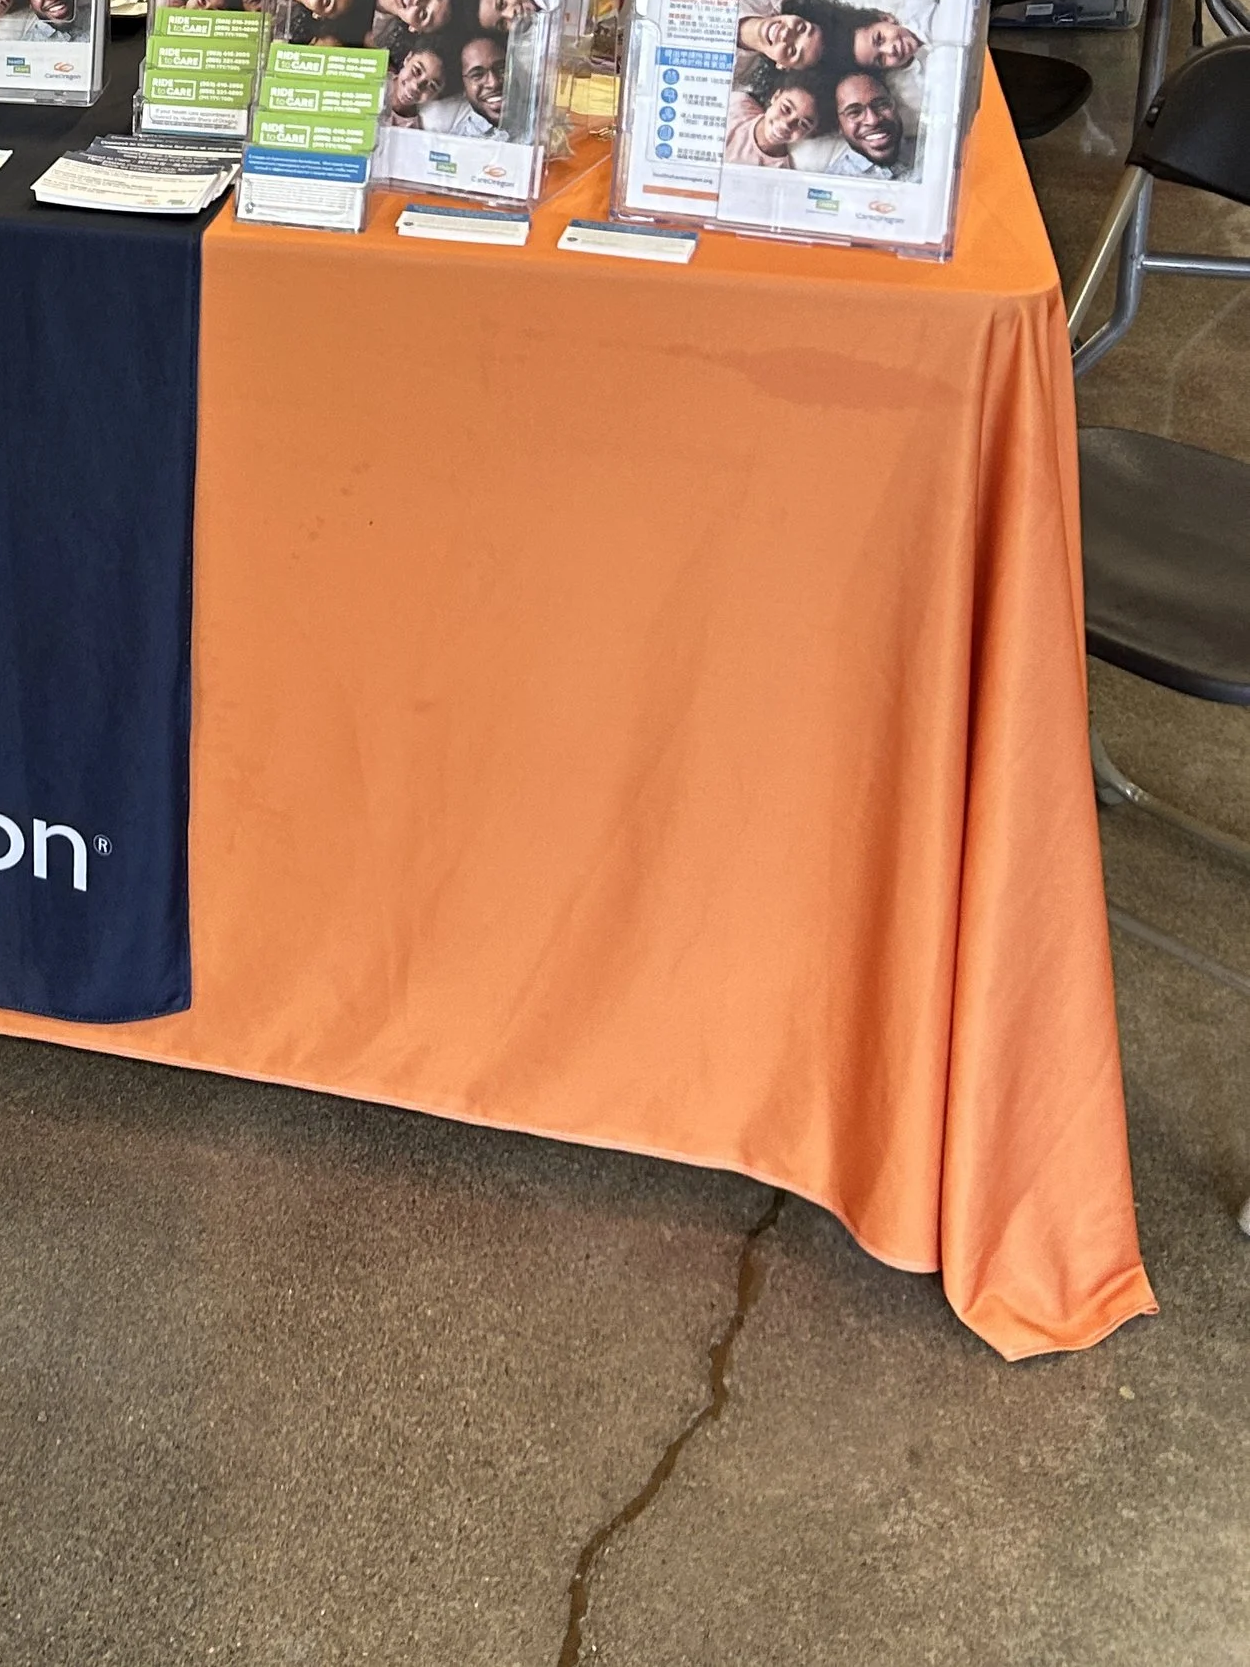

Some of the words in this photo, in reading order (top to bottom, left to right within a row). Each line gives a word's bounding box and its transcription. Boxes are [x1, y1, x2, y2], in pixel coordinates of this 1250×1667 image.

[169, 16, 190, 24] RIDE
[183, 25, 207, 33] CARE
[159, 48, 180, 56] RIDE
[277, 51, 300, 60] RIDE
[174, 57, 198, 65] CARE
[292, 62, 319, 71] CARE
[152, 78, 173, 87] RIDE
[166, 88, 192, 96] CARE
[271, 88, 294, 97] RIDE
[286, 98, 314, 107] CARE
[261, 122, 285, 132] RIDE
[277, 134, 305, 143] CARE
